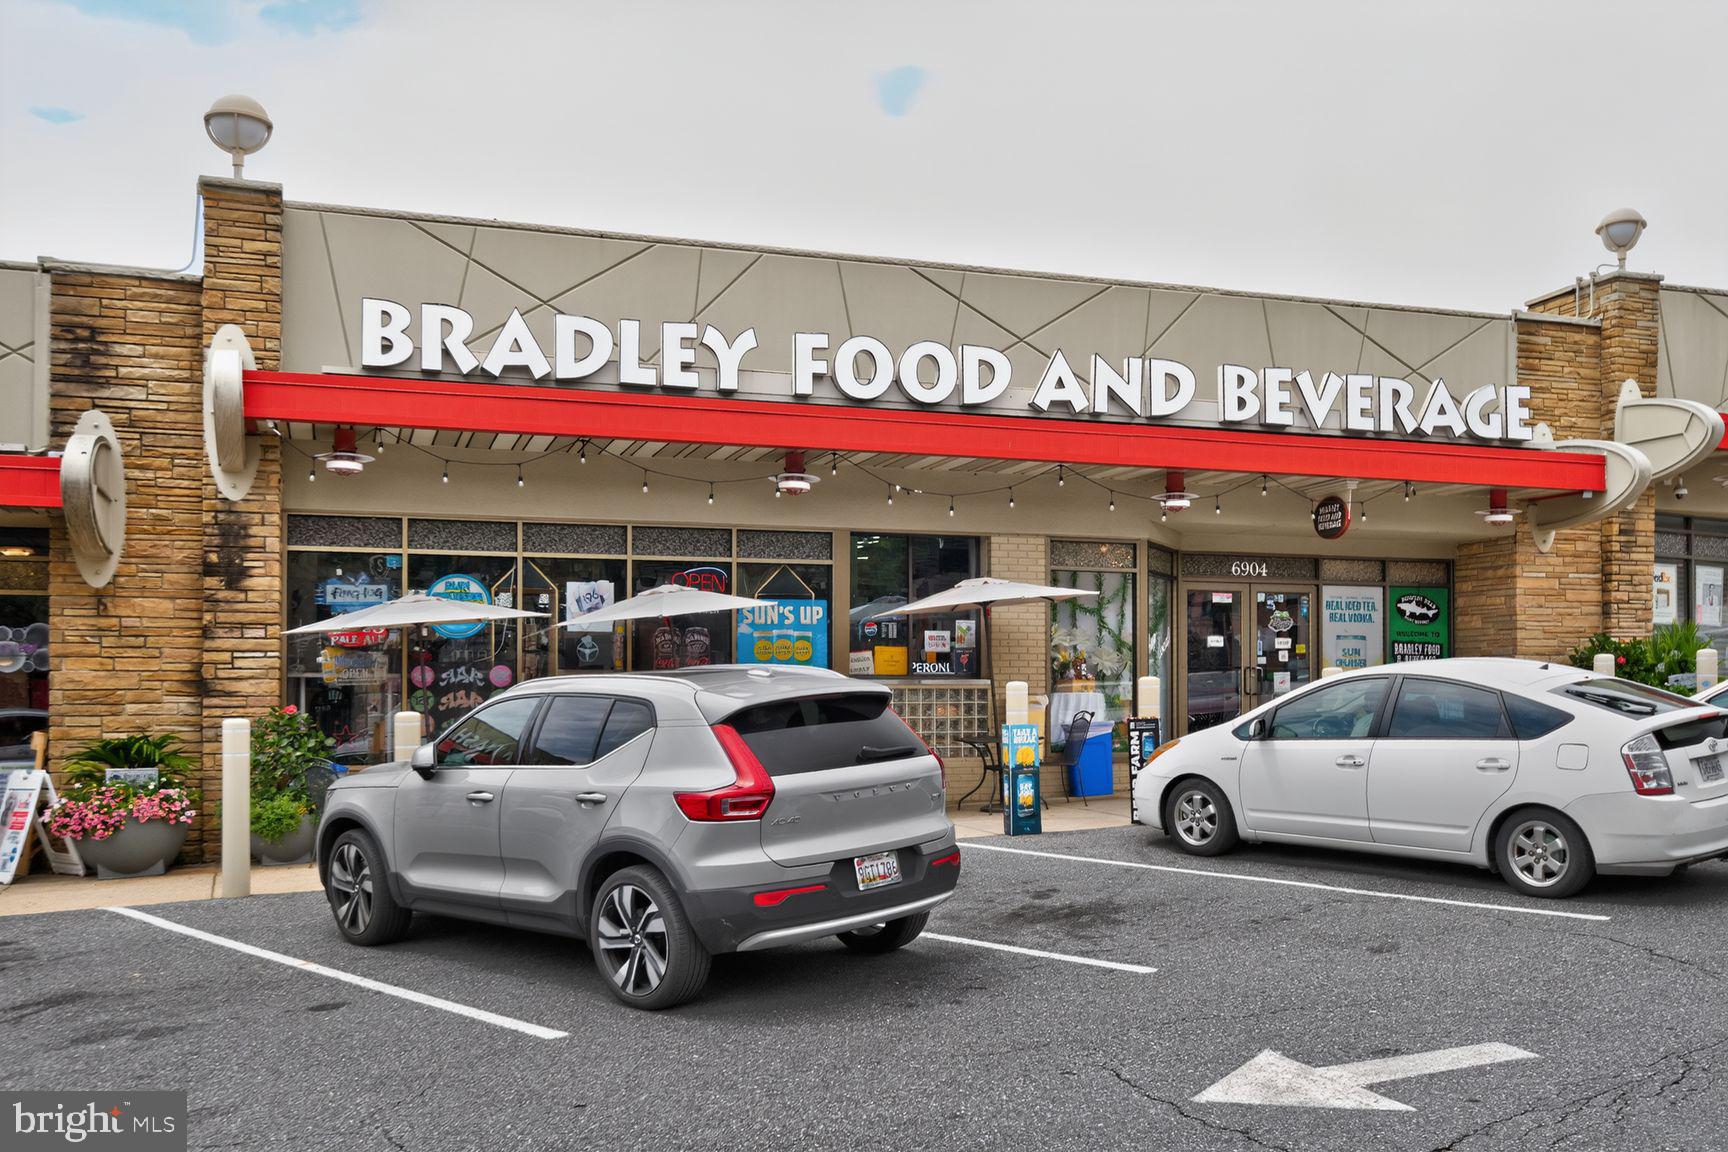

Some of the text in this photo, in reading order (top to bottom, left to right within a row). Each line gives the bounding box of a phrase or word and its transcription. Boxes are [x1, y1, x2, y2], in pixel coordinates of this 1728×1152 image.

[361, 297, 1533, 442] BRADLEY FOOD AND BEVERAGE
[1231, 561, 1268, 577] 6904
[671, 571, 727, 593] OPEN
[1325, 600, 1344, 610] REAL
[1345, 601, 1361, 611] ICED
[742, 605, 823, 625] SUN'S UP
[1329, 612, 1348, 623] REAL
[331, 634, 387, 646] PALE ALE
[1342, 647, 1361, 656] SUN
[1394, 643, 1441, 655] BRADLEY FOOD
[1130, 731, 1140, 775] FARM
[833, 782, 913, 802] VOLVO
